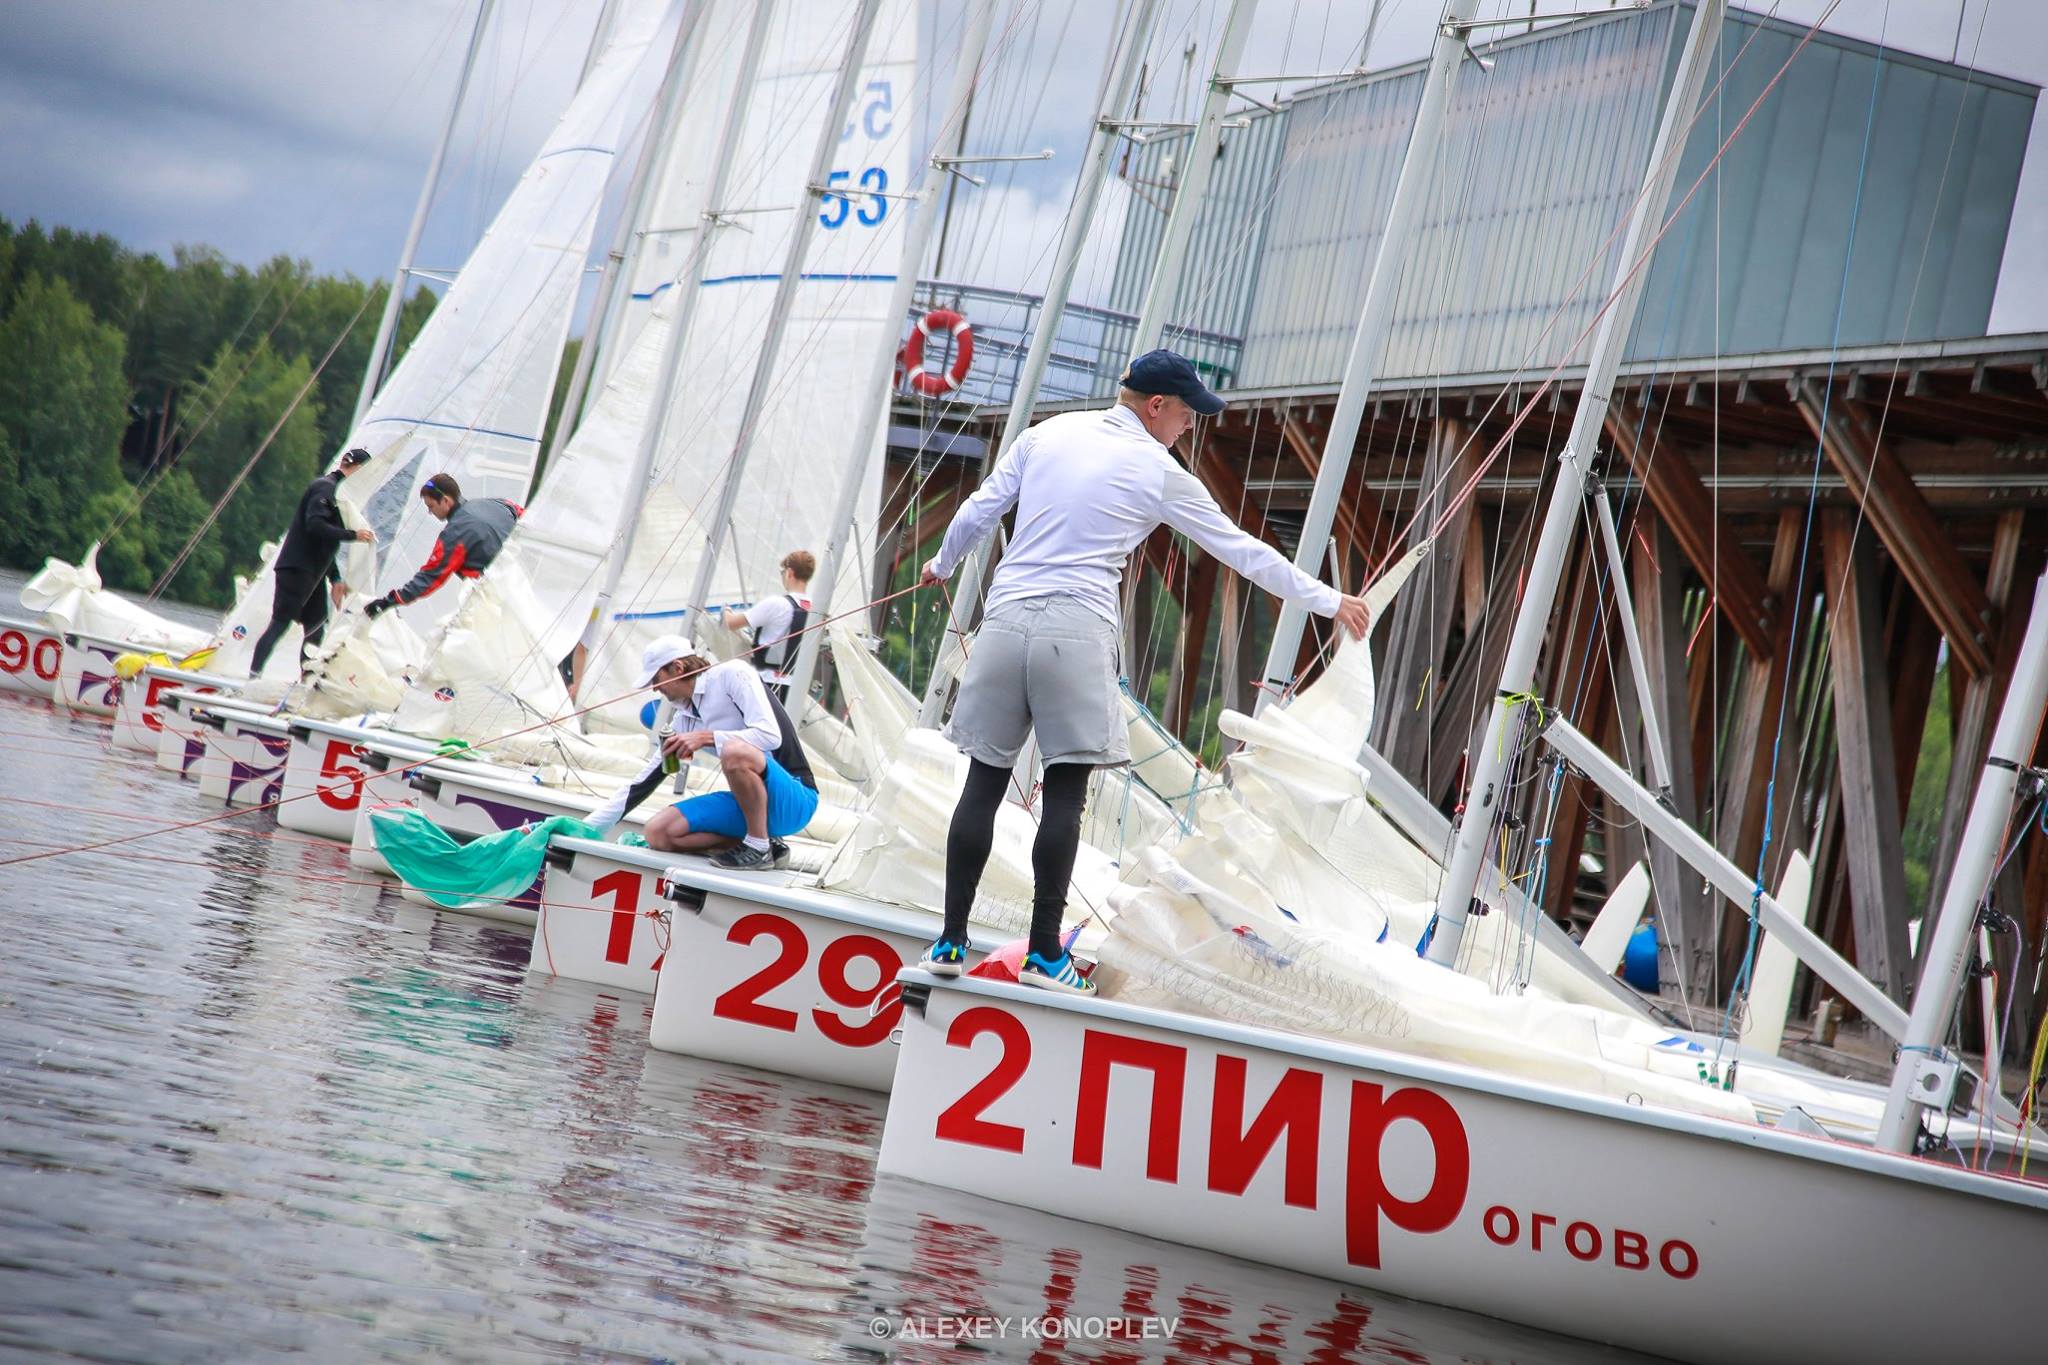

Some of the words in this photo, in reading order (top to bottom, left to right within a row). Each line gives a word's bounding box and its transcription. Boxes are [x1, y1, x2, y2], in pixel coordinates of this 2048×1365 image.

[818, 166, 889, 231] 53
[0, 629, 62, 682] 90
[590, 868, 669, 973] 1
[712, 912, 905, 1048] 29
[934, 1006, 1032, 1155] 2
